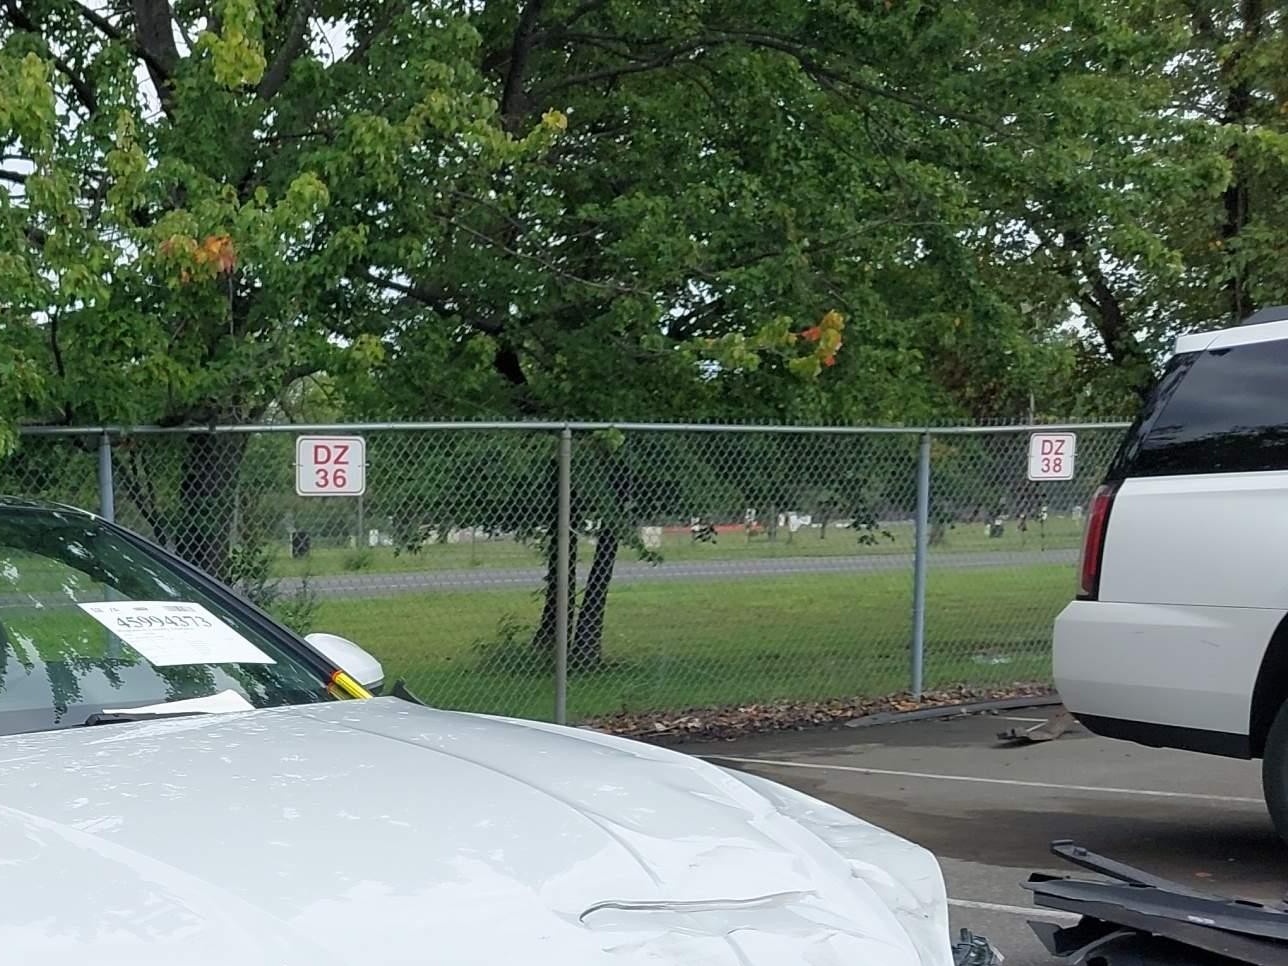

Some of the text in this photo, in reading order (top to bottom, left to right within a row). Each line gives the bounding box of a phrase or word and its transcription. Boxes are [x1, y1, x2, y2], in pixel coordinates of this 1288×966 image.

[313, 445, 350, 465] DZ
[1041, 439, 1066, 456] DZ
[1041, 457, 1063, 473] 38
[315, 468, 347, 489] 36
[116, 615, 213, 629] 45994373
